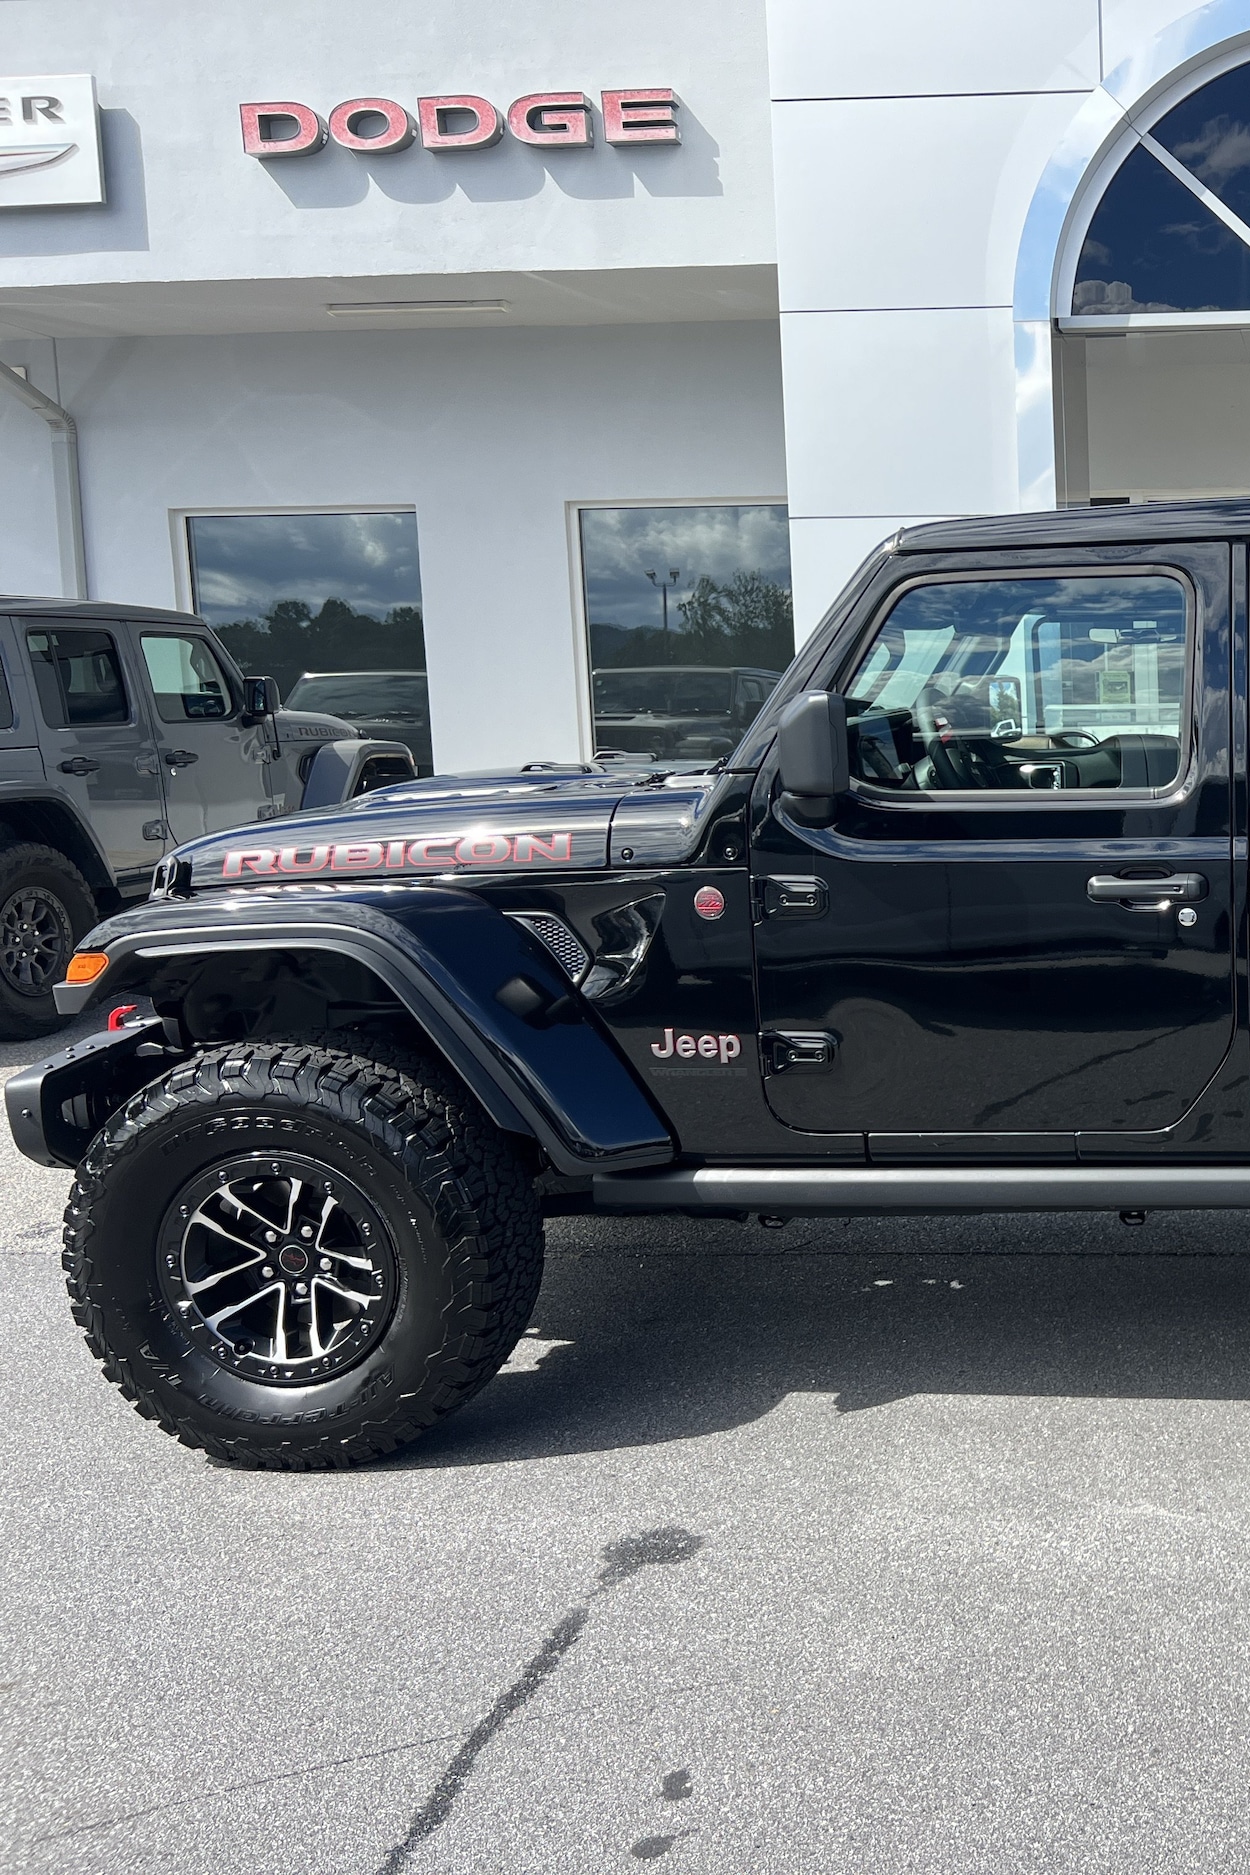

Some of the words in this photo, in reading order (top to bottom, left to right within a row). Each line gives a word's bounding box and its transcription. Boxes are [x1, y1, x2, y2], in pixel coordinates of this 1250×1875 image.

[239, 88, 682, 157] DODGE
[298, 726, 359, 738] RUBICON
[222, 832, 572, 877] RUBICON
[650, 1028, 742, 1064] Jeep
